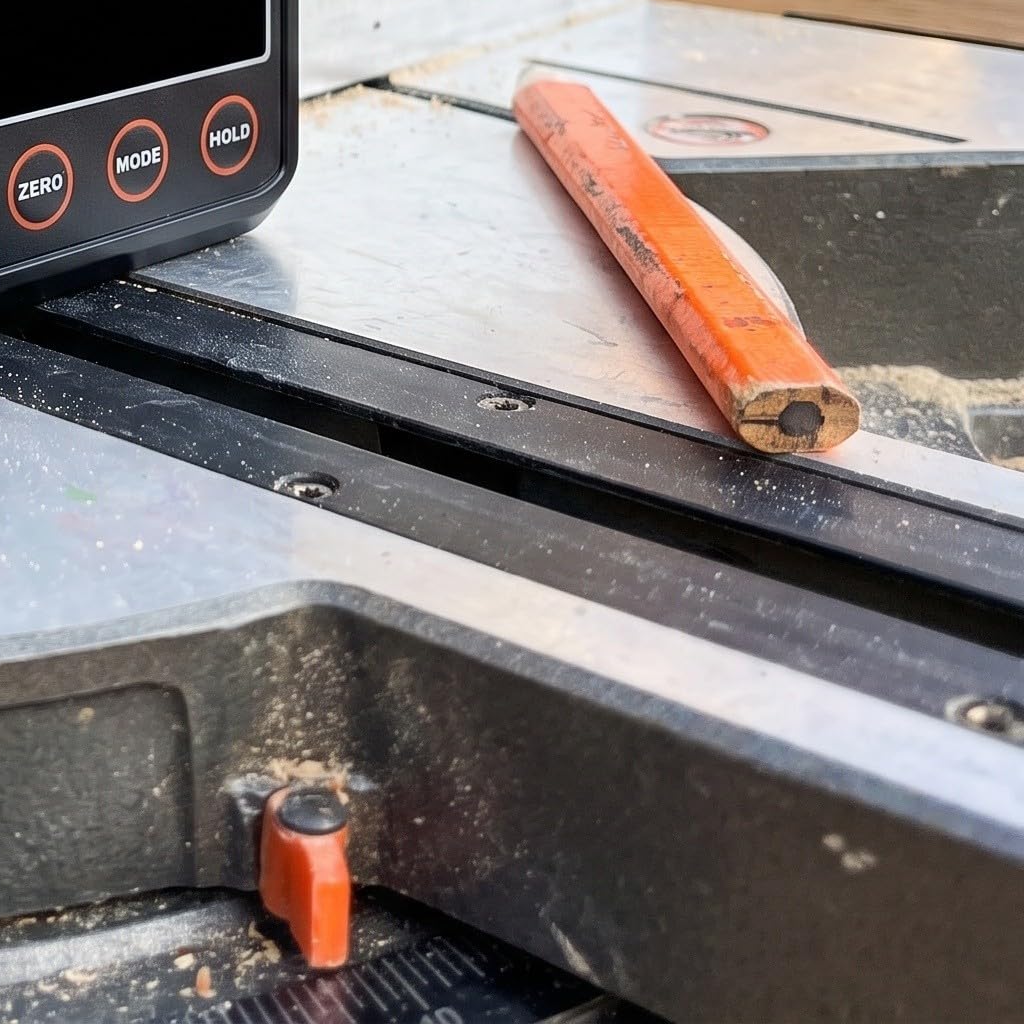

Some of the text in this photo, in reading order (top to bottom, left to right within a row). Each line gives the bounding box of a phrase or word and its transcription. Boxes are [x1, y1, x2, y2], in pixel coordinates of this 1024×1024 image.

[209, 123, 251, 148] HOLD
[116, 146, 162, 175] MODE
[17, 173, 64, 202] ZERO
